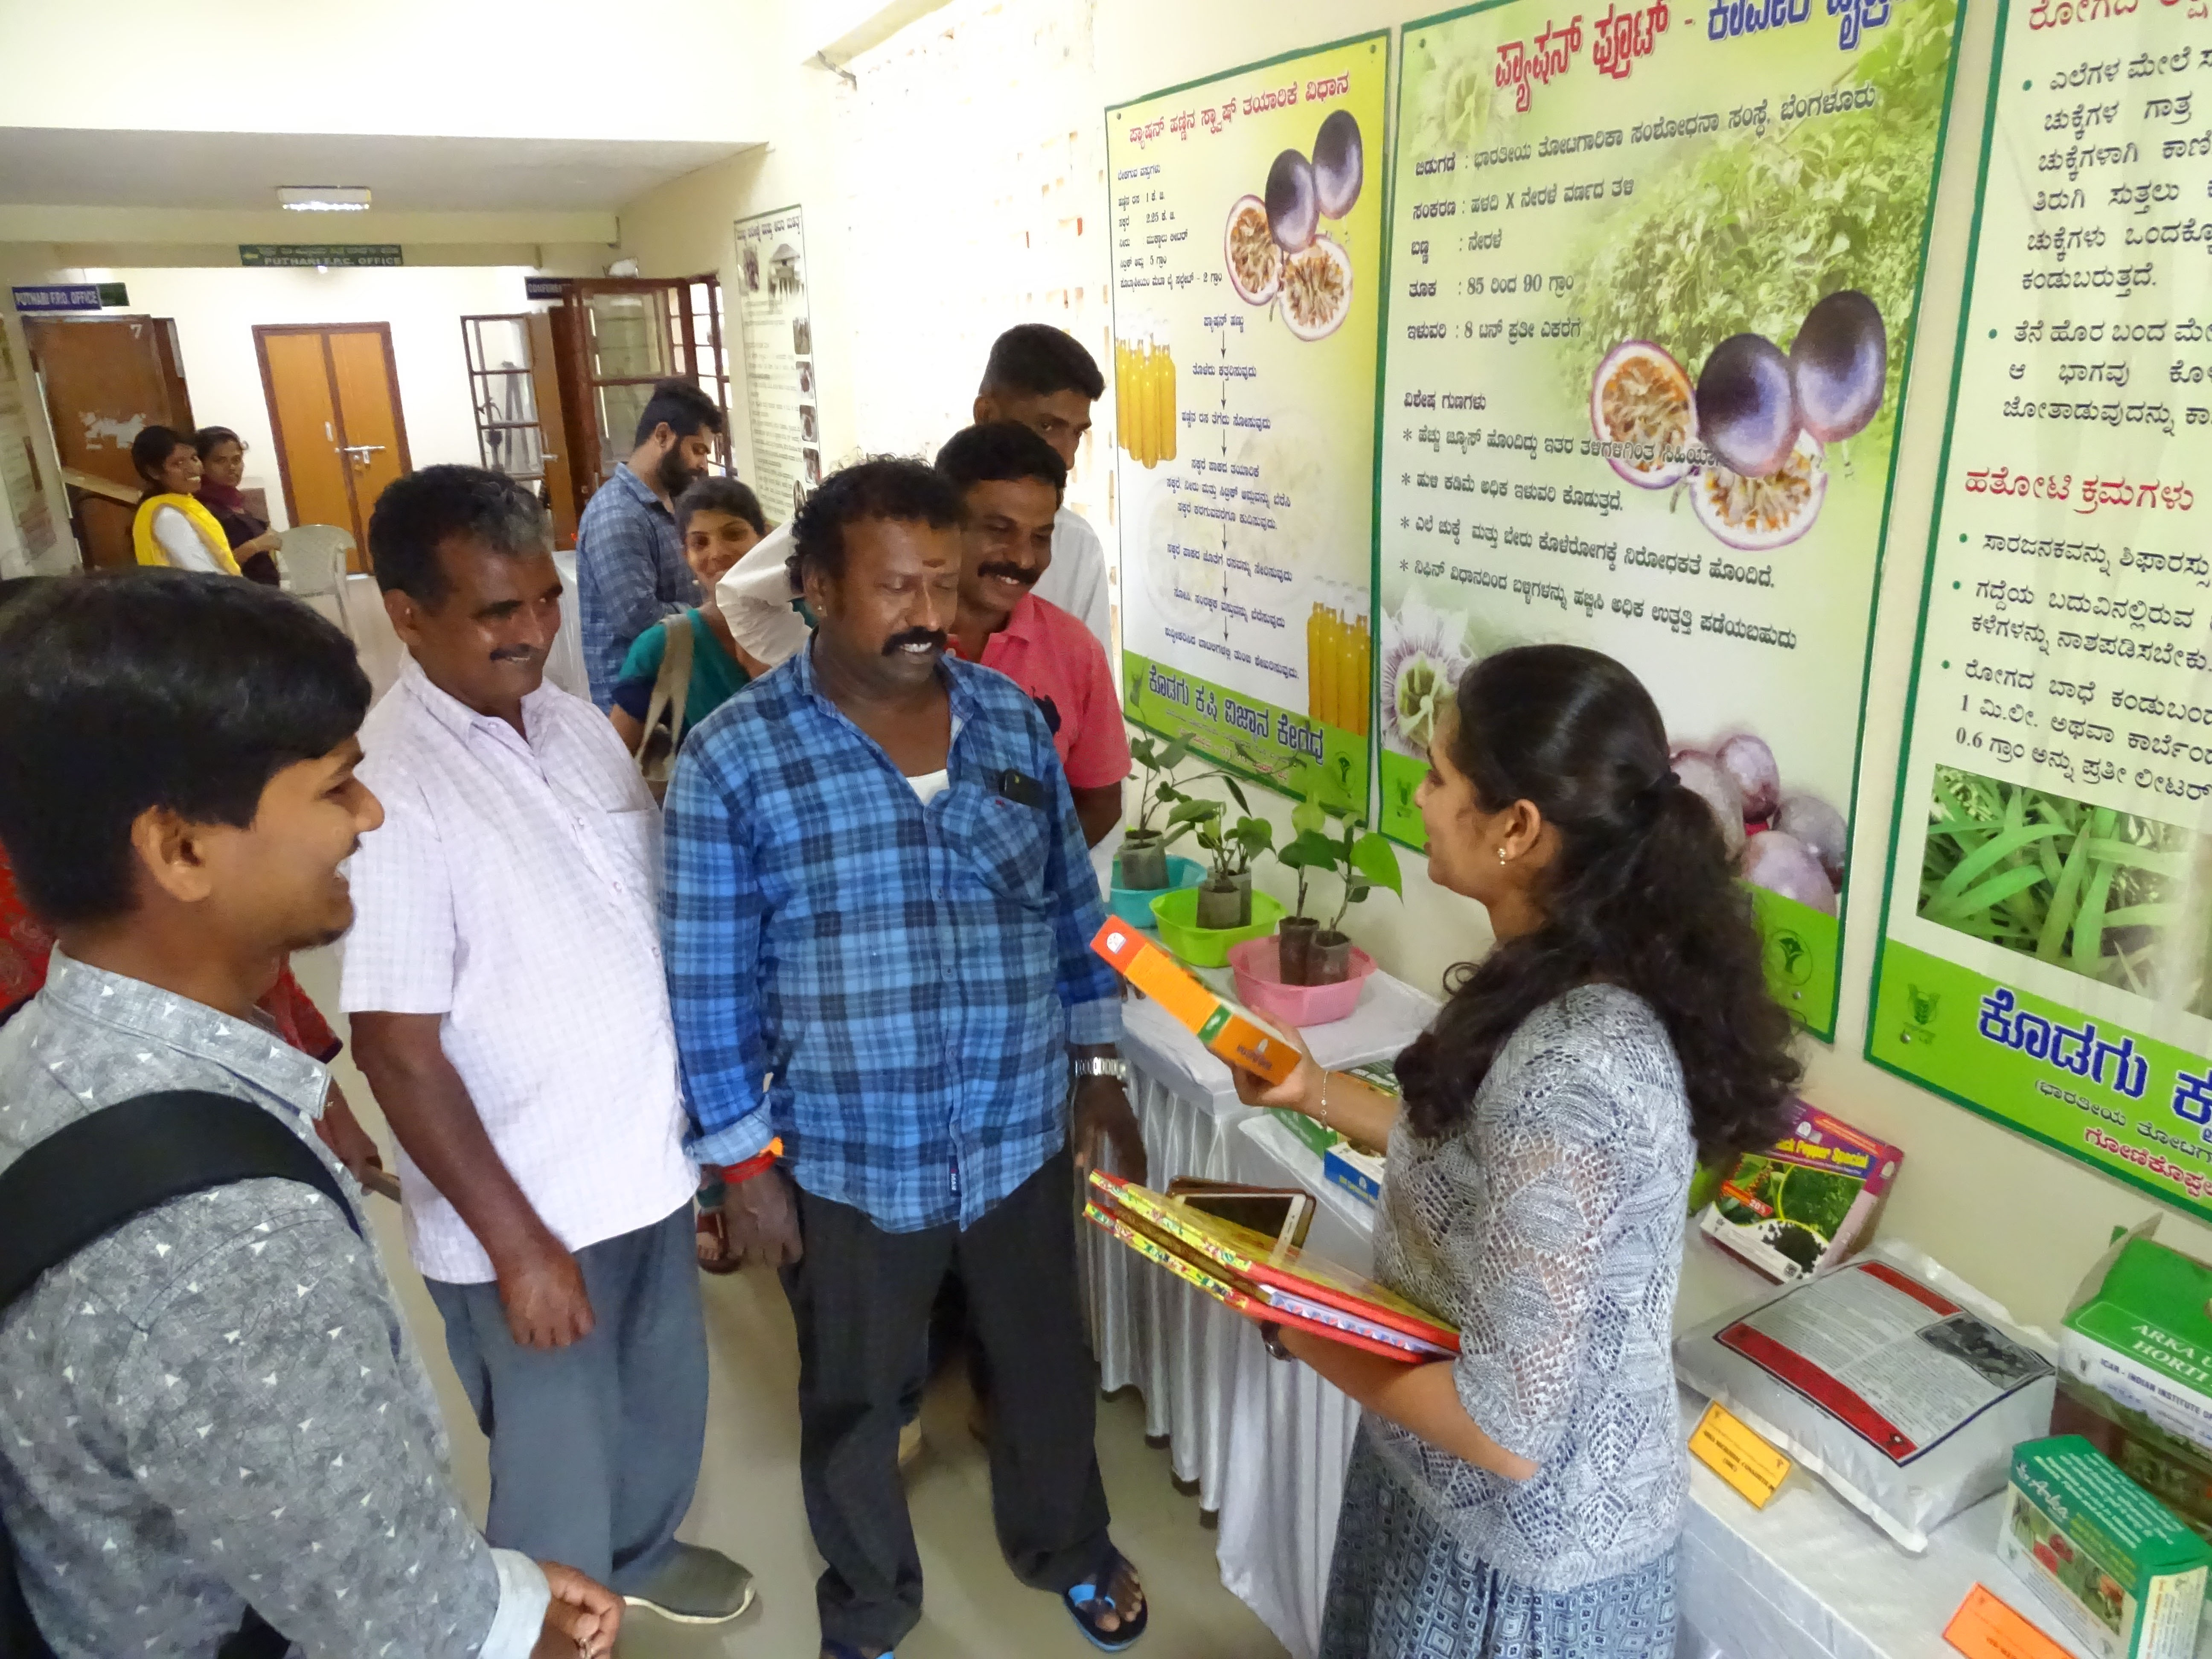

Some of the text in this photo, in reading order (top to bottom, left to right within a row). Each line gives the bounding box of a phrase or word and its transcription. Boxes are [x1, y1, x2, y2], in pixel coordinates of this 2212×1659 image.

[2049, 58, 2121, 90] ಎಲೆಗಳ
[2128, 46, 2192, 79] ಮೇಲೆ
[1305, 71, 1350, 103] ವಿಧಾನ
[1474, 143, 1531, 170] ಭಾರತೀಯ
[1538, 128, 1623, 158] ತೋಟಗಾರಿಕಾ
[1631, 112, 1719, 143] ಸಂಶೋಧನಾ
[1781, 81, 1876, 122] ಬೆಂಗಳೂರು
[2044, 90, 2193, 140] ಚುಕ್ಕೆಗಳ ಗಾತ್ರ
[2038, 141, 2139, 181] ಚುಕ್ಕೆಗಳಾಗಿ
[1520, 183, 1558, 208] ನೇರಳೆ
[1612, 176, 1634, 197] ತಳಿ
[2033, 188, 2085, 211] ತಿರುಗಿ
[2108, 179, 2180, 215] ಸುತ್ತಲು
[1468, 228, 1502, 251] ನೇರಳೆ
[2027, 225, 2105, 262] ಚುಕ್ಕೆಗಳು
[1409, 274, 1574, 298] ತೂಕ 85 ರಿಂದ 90 ಗ್ರಾಂ
[2022, 262, 2156, 297] ಕಂಡುಬರುತ್ತದೆ.
[130, 324, 143, 338] 7
[1464, 321, 1473, 338] 8
[1479, 319, 1502, 338] ಟನ್
[2014, 319, 2168, 343] ತೆನೆ ಹೊರ ಬಂದ
[2059, 360, 2129, 387] ಭಾಗವು
[1403, 389, 1487, 411] ವಿಶೇಷ ಗುಣಗಳು
[1417, 470, 1438, 489] ಹುಳಿ
[1444, 473, 1476, 494] ಕಡಿಮೆ
[1514, 484, 1556, 503] ಇಳುವರಿ
[1965, 466, 2194, 514] ಹತೋಟಿ ಕ್ರಮಗಳು
[1415, 515, 1433, 532] ಎಲೆ
[1439, 518, 1461, 545] ಚುಕ್ಕೆ
[1472, 523, 1498, 548] ಮತ್ತು
[1504, 526, 1533, 548] ಬೇರು
[1983, 533, 2110, 576] ಸಾರಜನಕವನ್ನು
[1450, 565, 1508, 590] ವಿಧಾನದಿಂದ
[1611, 597, 1644, 618] ಅಧಿಕ
[1700, 612, 1797, 650] ಪಡೆಯಬಹುದು
[1976, 579, 2034, 611] ಗದ್ದೆಯ
[1971, 614, 2049, 655] ಕಳೆಗಳನ್ನು
[1149, 664, 1188, 706] ಕೊಡಗು
[1965, 658, 2096, 705] ರೋಗದ ಬಾಧೆ
[1960, 693, 1969, 712] 1
[2051, 715, 2115, 743] ಅಥವಾ
[1956, 727, 2212, 800] 0.6 ಗ್ರಾಂ ಅನ್ನು ಪ್ರತೀ ಲೀಟರ್
[1979, 987, 2148, 1099] ಕೊಡಗು
[2131, 1325, 2195, 1359] ARKA
[2128, 1372, 2156, 1392] INDIAN
[2158, 1387, 2200, 1415] INSTITUTE
